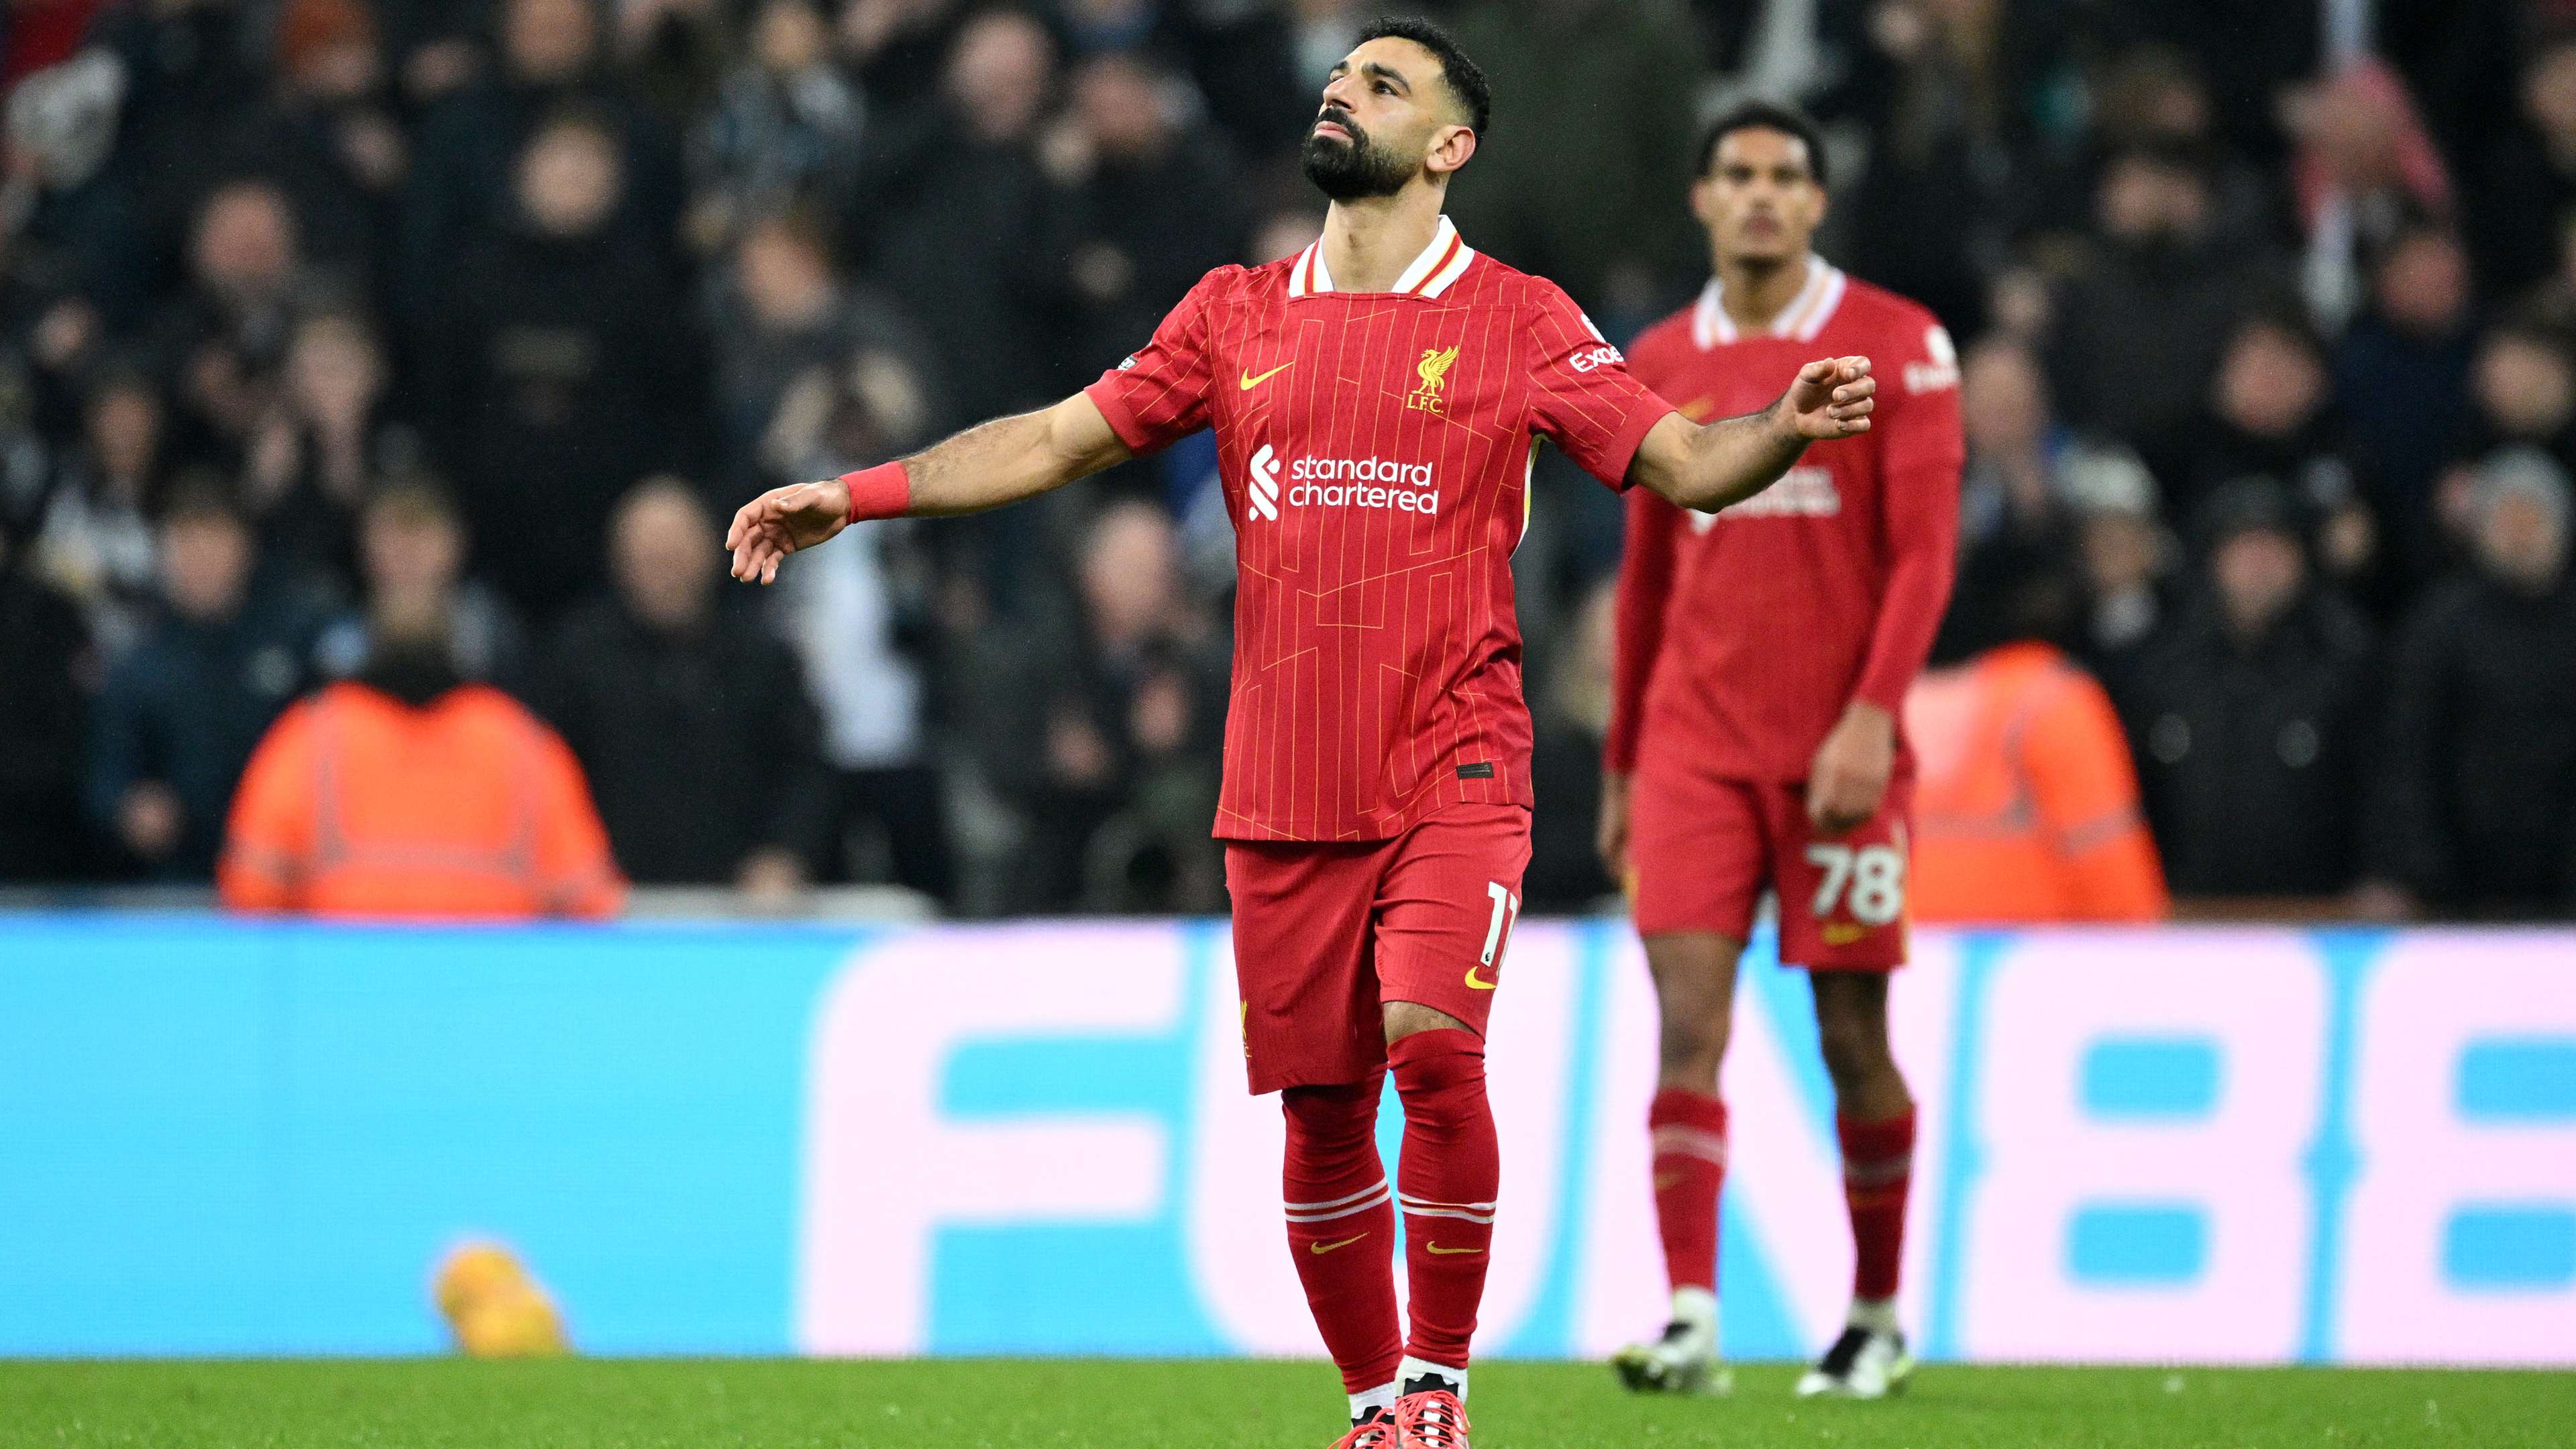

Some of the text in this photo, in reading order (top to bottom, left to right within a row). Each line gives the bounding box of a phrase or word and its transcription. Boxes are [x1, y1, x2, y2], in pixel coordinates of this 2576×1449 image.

[1289, 480, 1439, 515] chartered
[1291, 454, 1433, 487] standard
[1806, 844, 1904, 926] 78
[1480, 881, 1518, 977] 11
